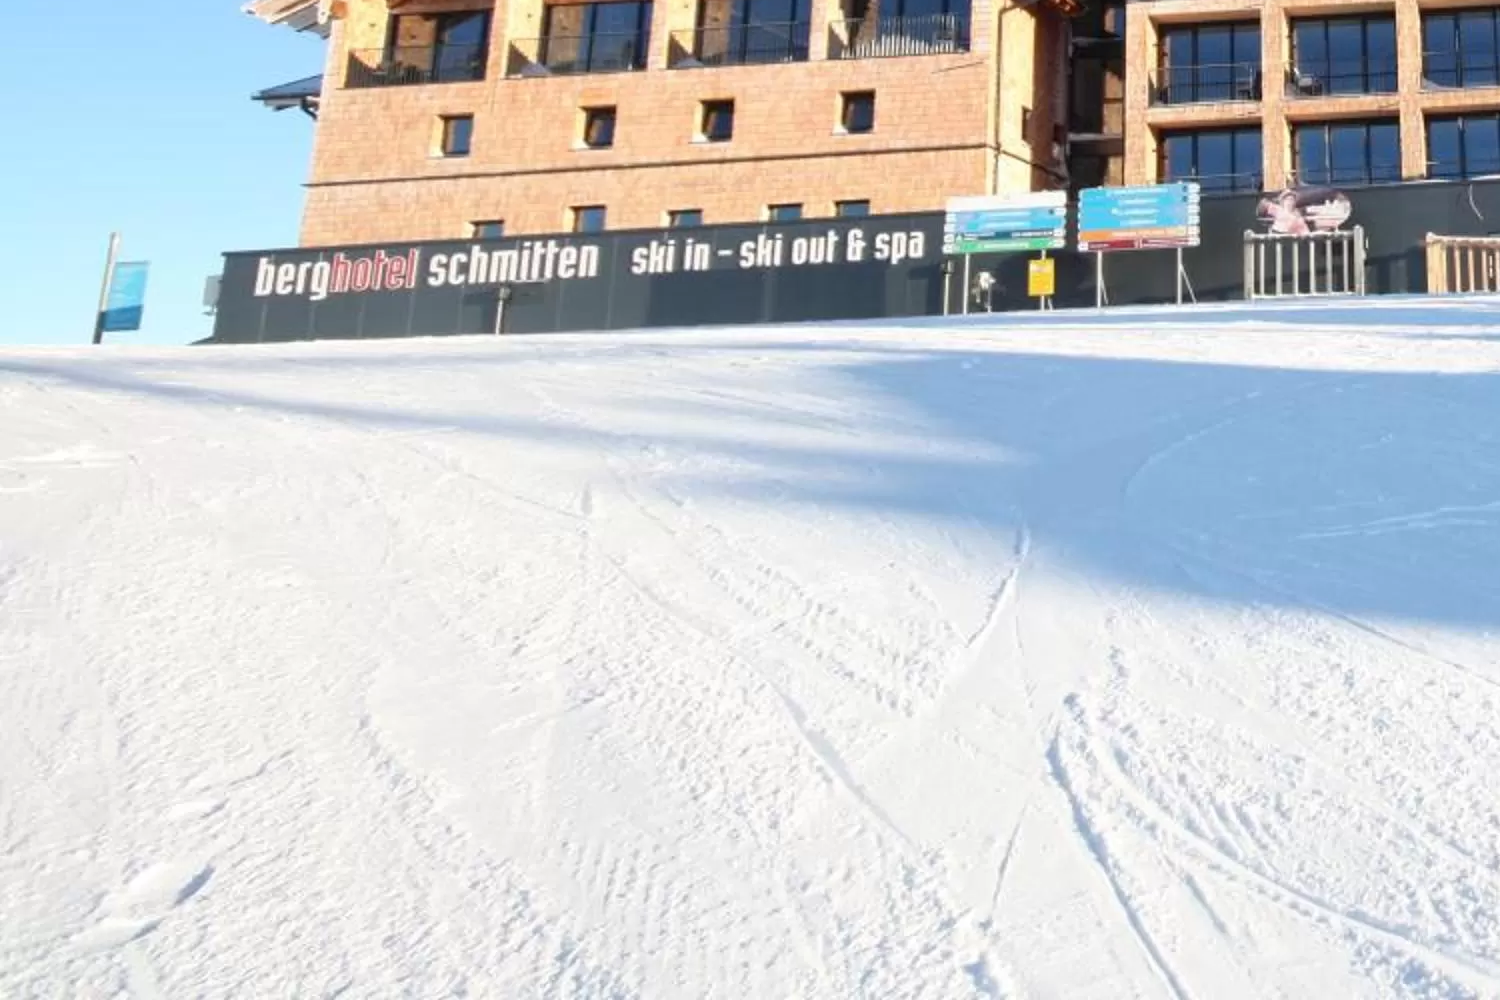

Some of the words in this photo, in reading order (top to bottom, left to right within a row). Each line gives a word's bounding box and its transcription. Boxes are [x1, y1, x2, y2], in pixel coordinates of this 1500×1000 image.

[254, 248, 417, 301] berghotel
[427, 242, 599, 287] schmitten
[631, 238, 675, 275] ski
[683, 237, 710, 271] in
[739, 232, 783, 269] ski
[791, 229, 839, 265] out
[846, 227, 867, 263] &
[874, 230, 925, 265] spa
